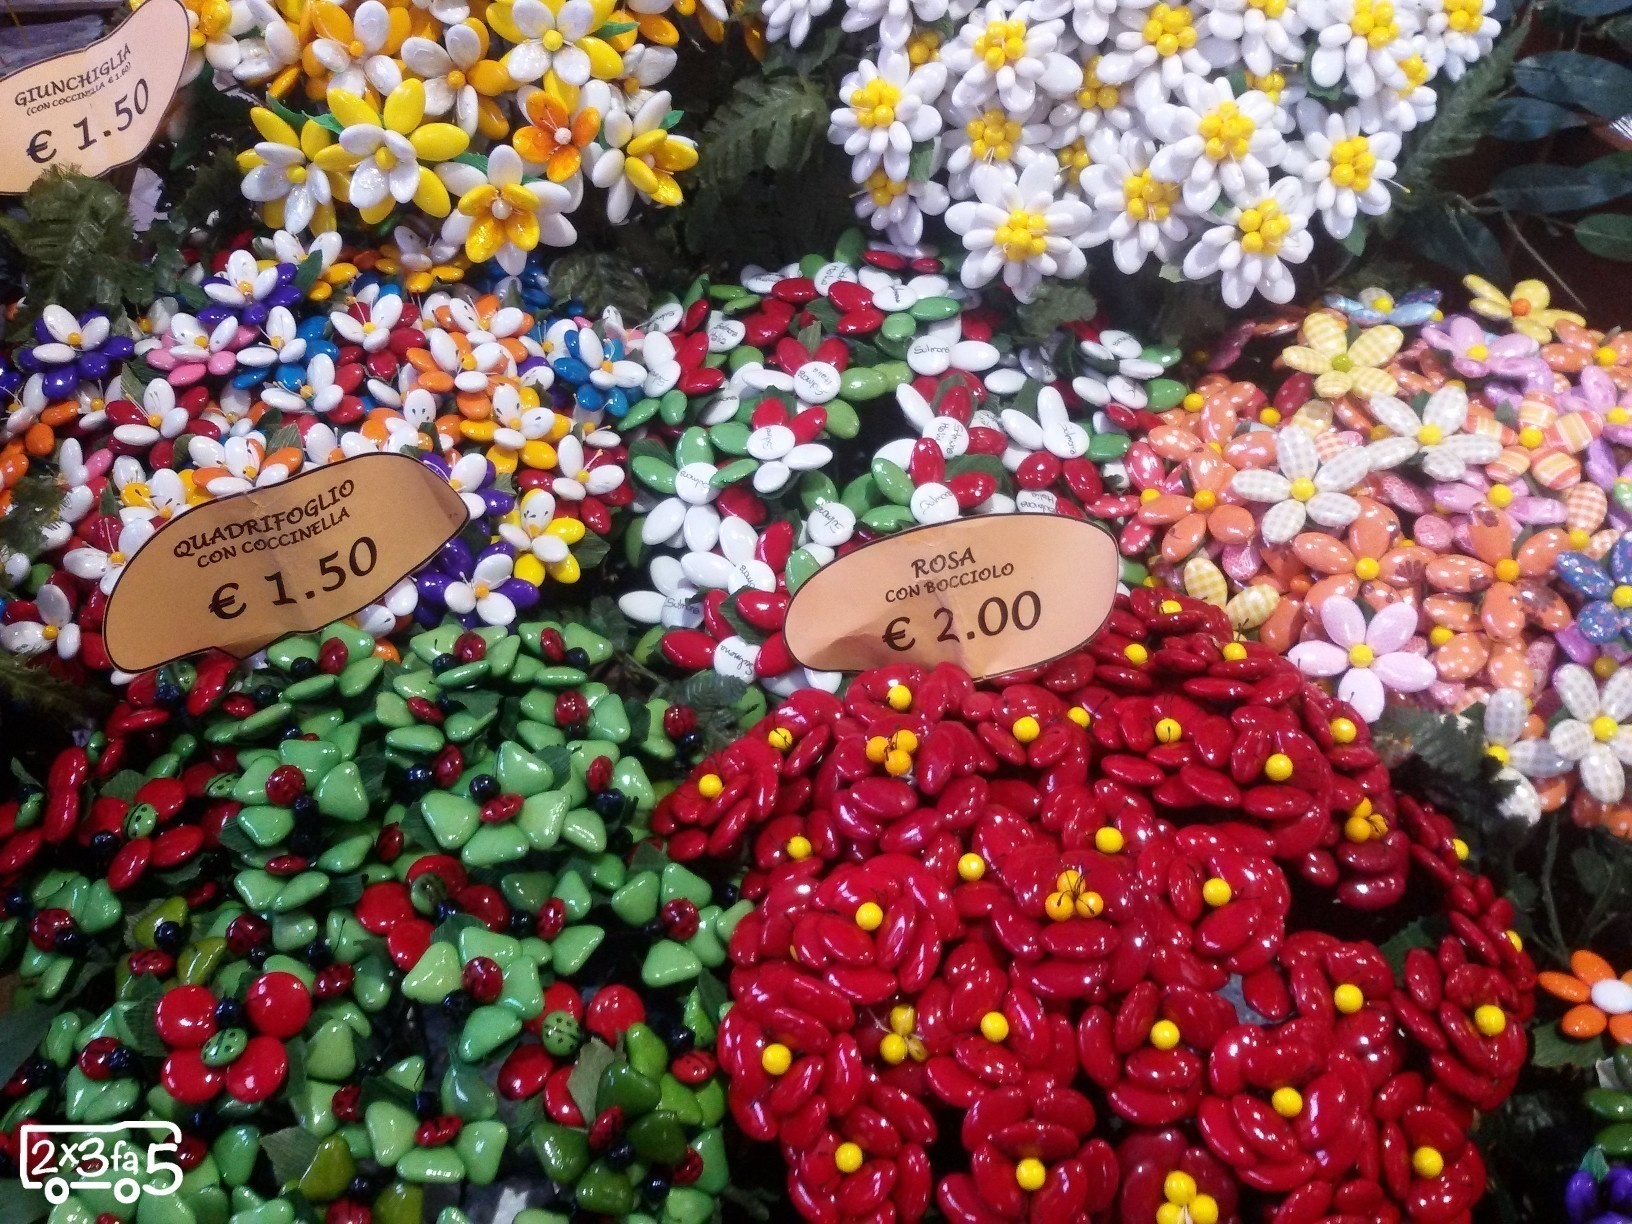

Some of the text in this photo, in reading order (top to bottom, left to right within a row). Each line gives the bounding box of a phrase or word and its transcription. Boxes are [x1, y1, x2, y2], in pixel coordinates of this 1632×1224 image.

[14, 42, 132, 107] GIUNCHIGLIA
[26, 100, 51, 117] (CON
[26, 78, 149, 164] € 1.50
[913, 344, 950, 356] Sulmona
[173, 478, 356, 558] QUADRIFOGLIO
[197, 506, 351, 569] CON COCCINELLA
[208, 535, 379, 621] € 1.50
[885, 562, 1015, 604] CON BOCCIOLO
[911, 546, 977, 579] ROSA
[882, 590, 1042, 652] € 2.00
